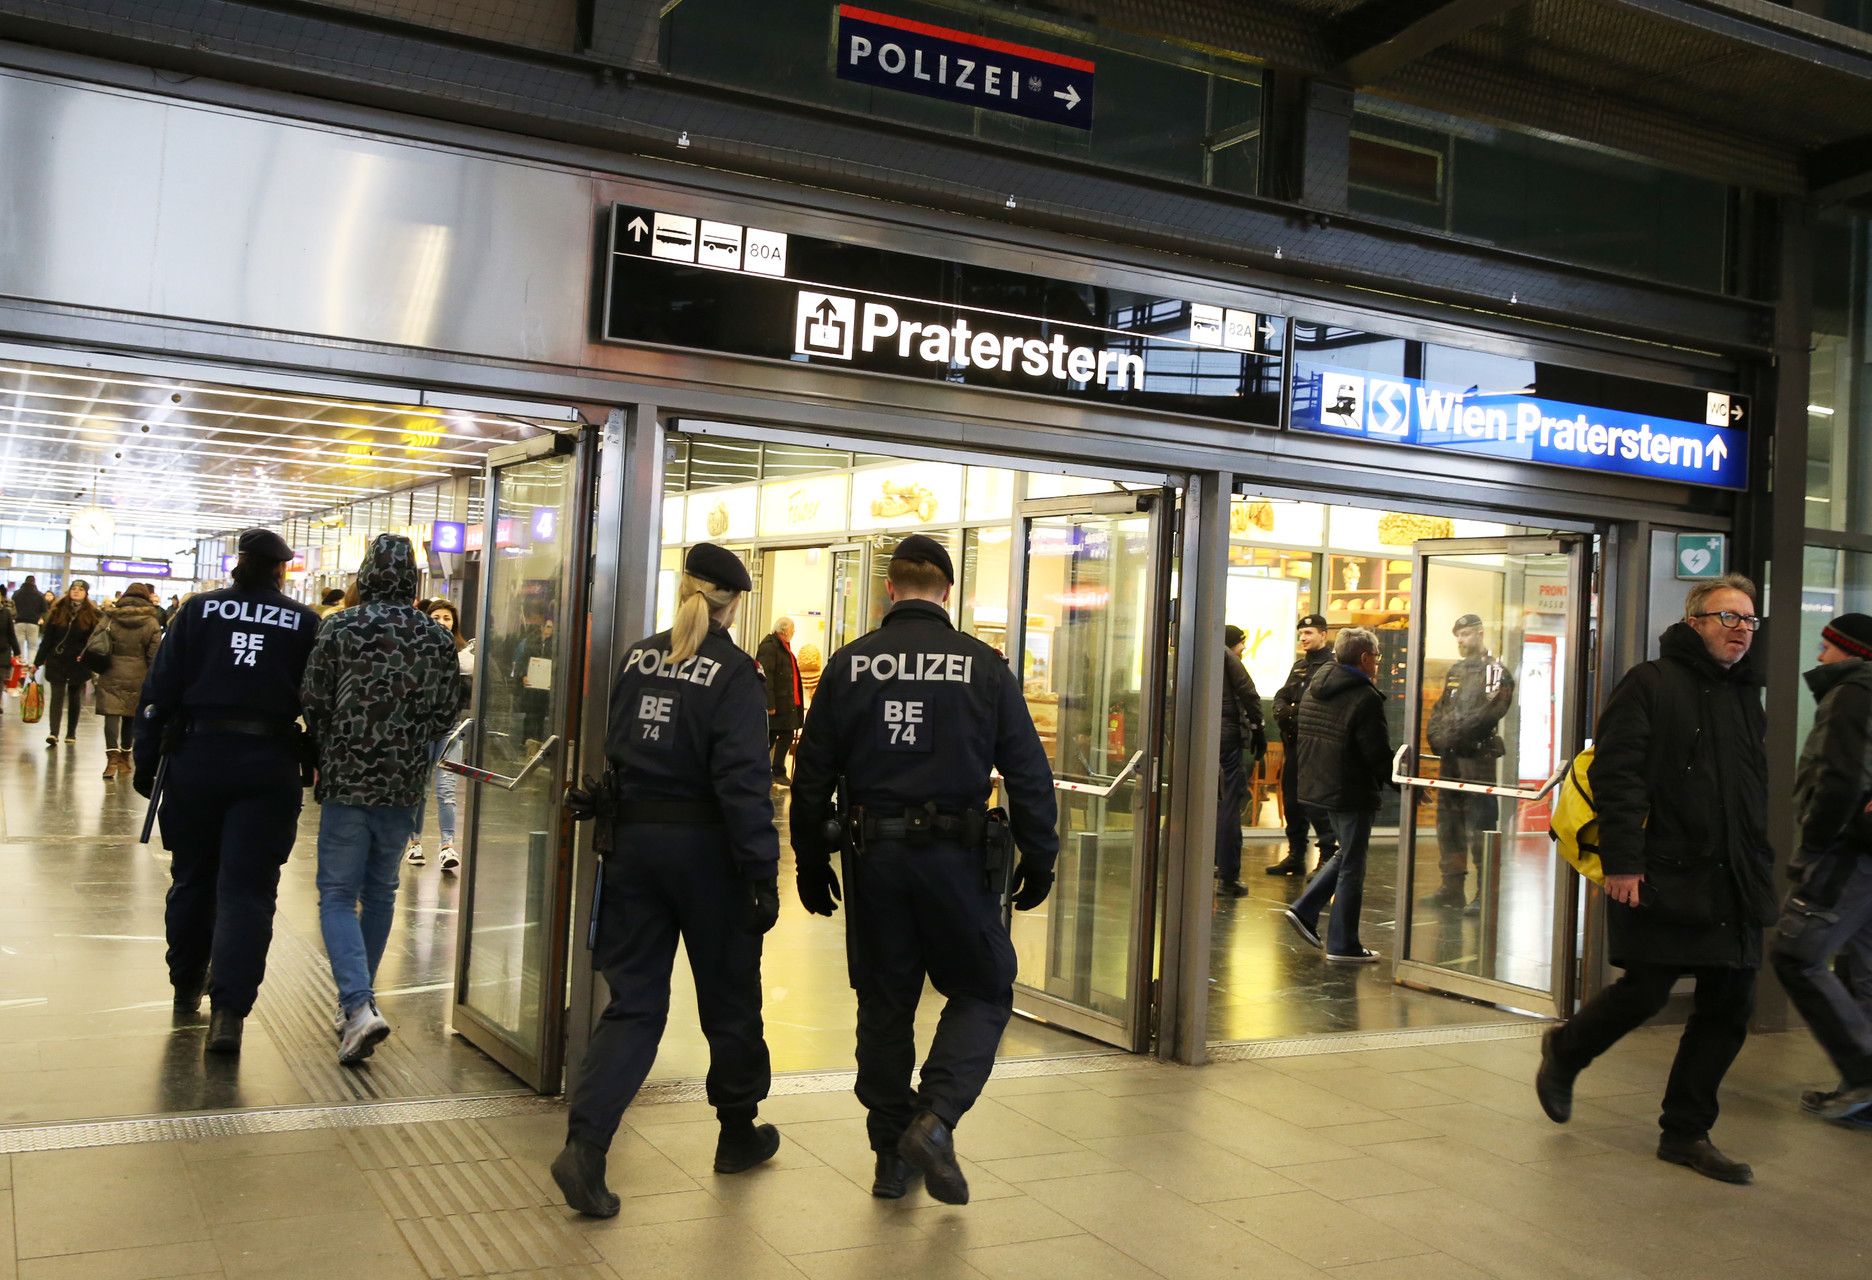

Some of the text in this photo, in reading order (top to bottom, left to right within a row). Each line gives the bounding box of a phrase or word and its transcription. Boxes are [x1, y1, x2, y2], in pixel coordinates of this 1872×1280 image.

[850, 35, 1019, 100] POLIZEI
[750, 243, 781, 261] 80A
[1228, 322, 1252, 338] 82A
[861, 302, 1145, 390] Praterstern
[1710, 402, 1727, 416] WC
[1415, 386, 1508, 441] Wien
[1516, 402, 1703, 470] Praterstern
[438, 525, 458, 549] 3
[536, 512, 553, 538] 4
[202, 600, 301, 631] POLIZEI
[230, 631, 265, 651] BE
[233, 649, 256, 666] 74
[623, 648, 722, 687] POLIZEI
[850, 653, 973, 683] POLIZEI
[638, 695, 673, 723] BE
[884, 700, 924, 723] BE
[642, 724, 660, 741] 74
[888, 724, 916, 745] 74
